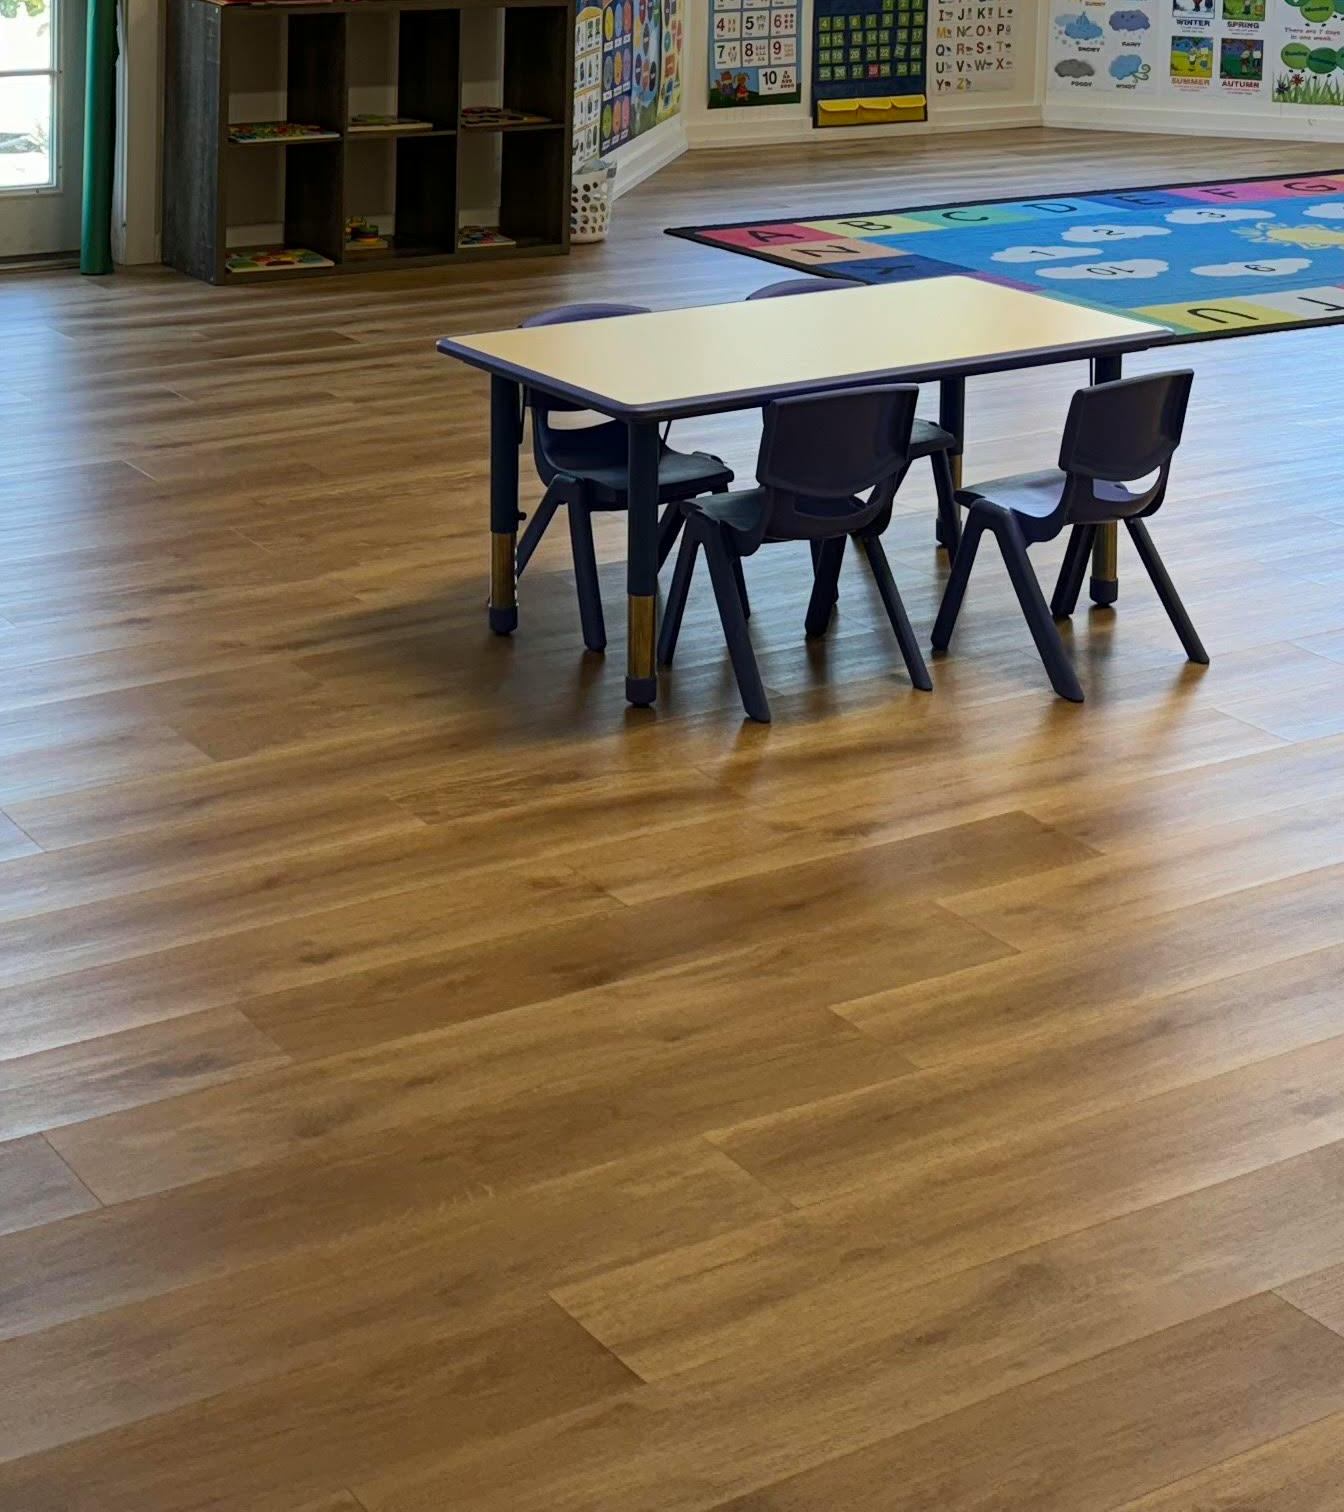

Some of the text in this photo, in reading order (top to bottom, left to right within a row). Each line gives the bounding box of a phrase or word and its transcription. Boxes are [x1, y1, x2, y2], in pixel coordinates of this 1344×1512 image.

[939, 7, 1004, 21] I J K L
[717, 14, 782, 31] 4 5 6
[936, 24, 1004, 38] M N O P
[717, 41, 781, 58] 7 8 9
[880, 48, 889, 57] 22
[936, 41, 1004, 56] Q R S T
[936, 58, 1004, 73] U V W X
[762, 71, 777, 85] 10
[936, 78, 965, 91] Y Z
[1171, 77, 1210, 86] SUMMER
[1222, 80, 1259, 88] AUTUMN
[941, 211, 989, 221] C
[838, 220, 893, 231] B
[748, 230, 805, 243] A
